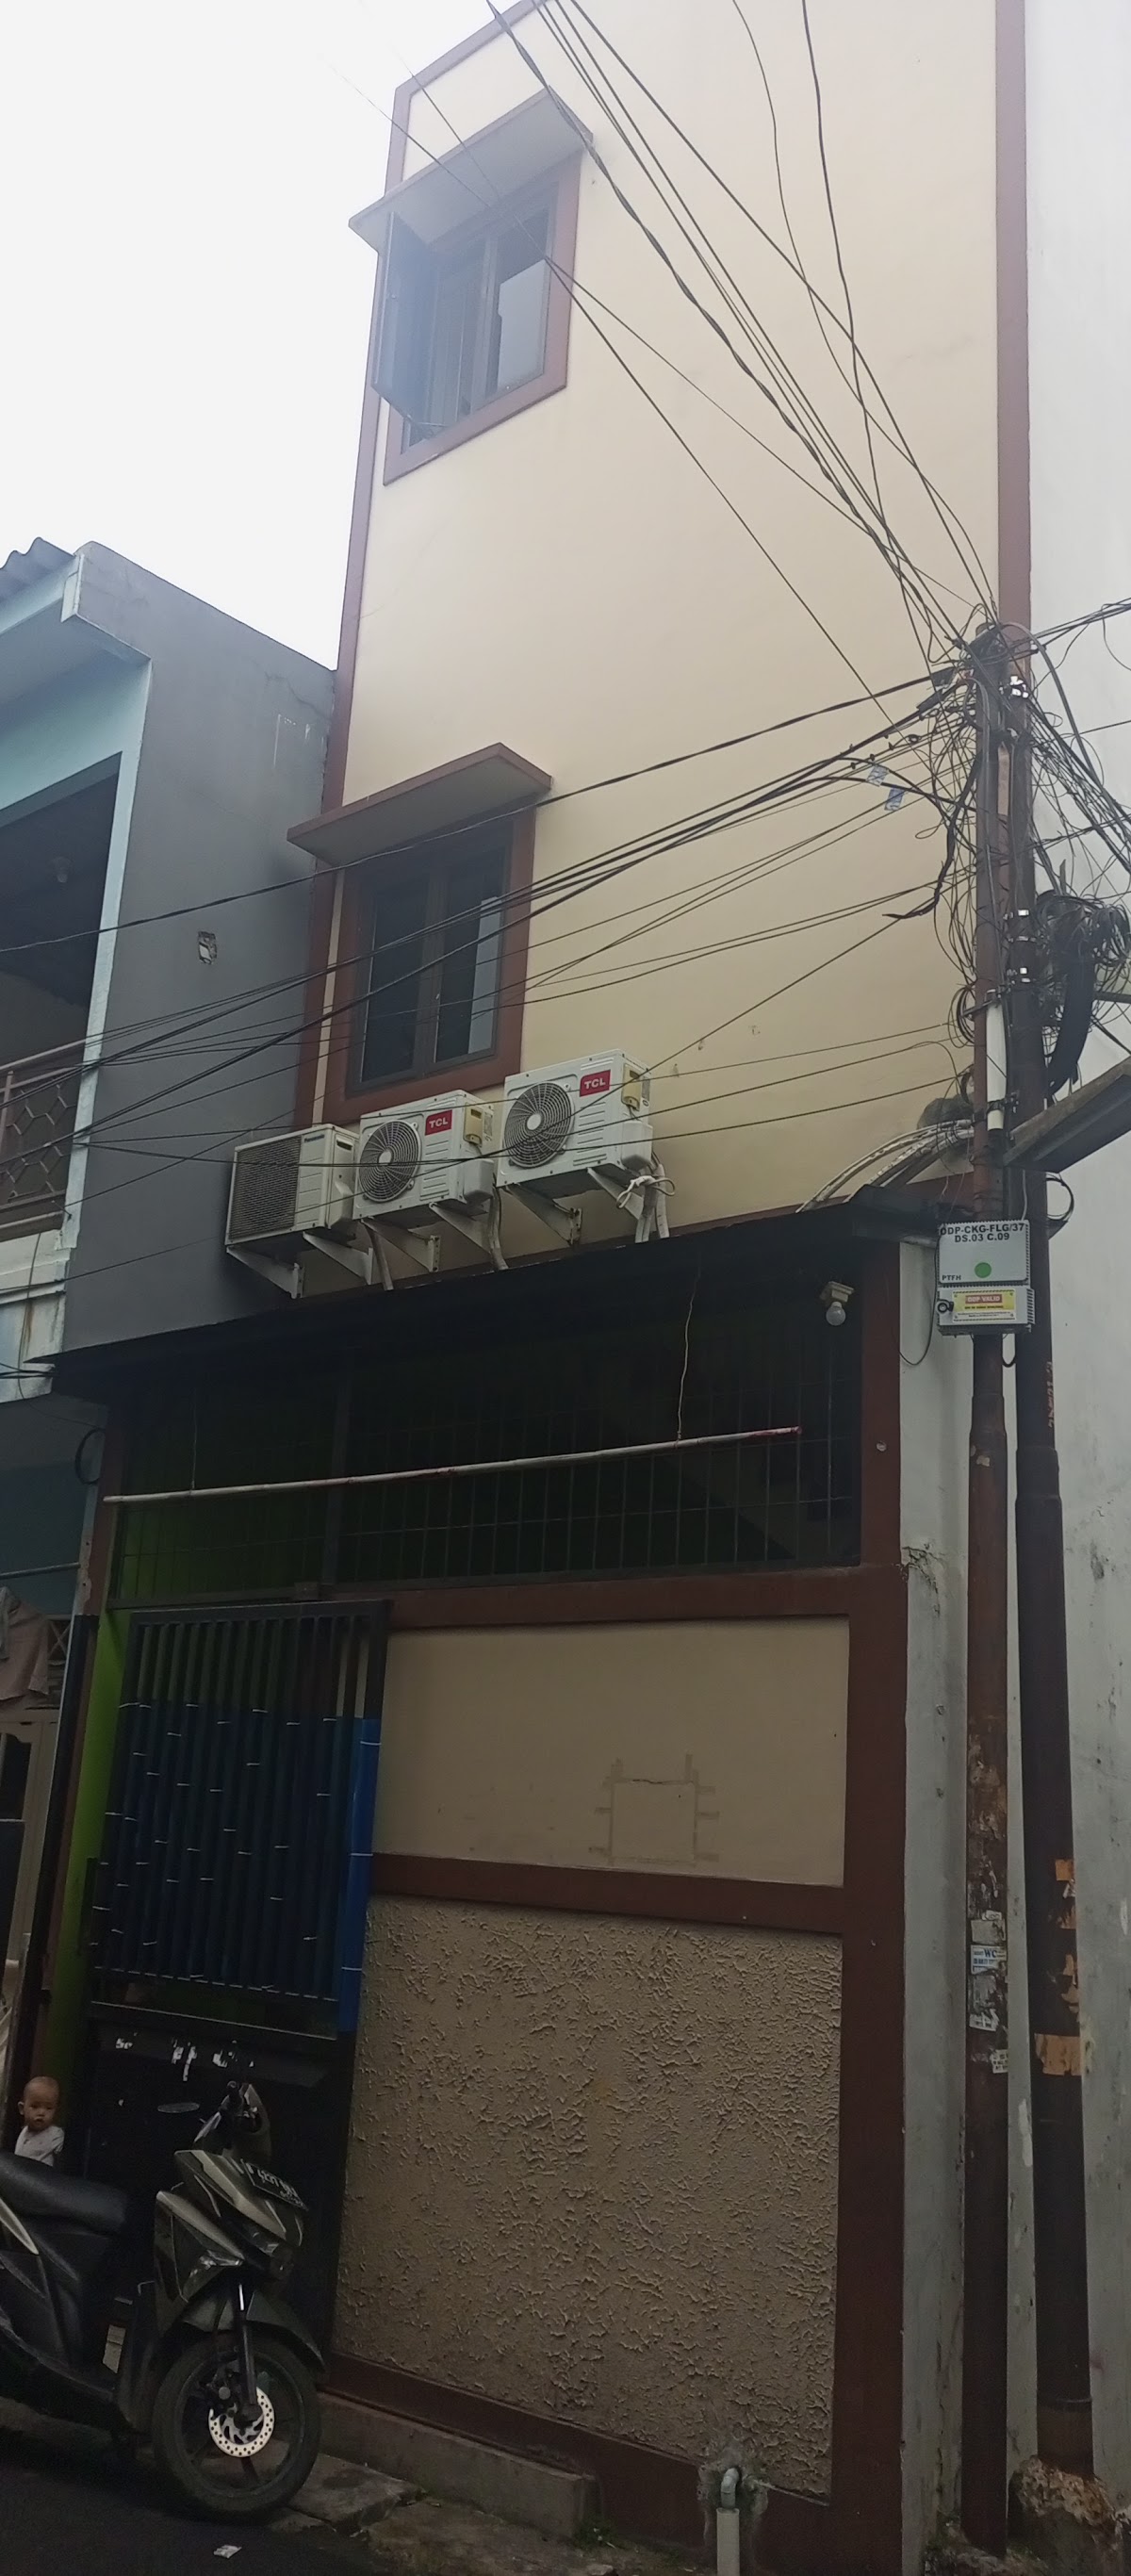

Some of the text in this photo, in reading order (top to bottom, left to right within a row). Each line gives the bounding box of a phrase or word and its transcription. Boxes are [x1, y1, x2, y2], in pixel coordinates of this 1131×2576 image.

[584, 1078, 606, 1090] TCL
[429, 1117, 449, 1128] TCL
[940, 1222, 1024, 1236] ODP-CKG-FLG/37
[955, 1232, 1010, 1243] DS.03 C.09
